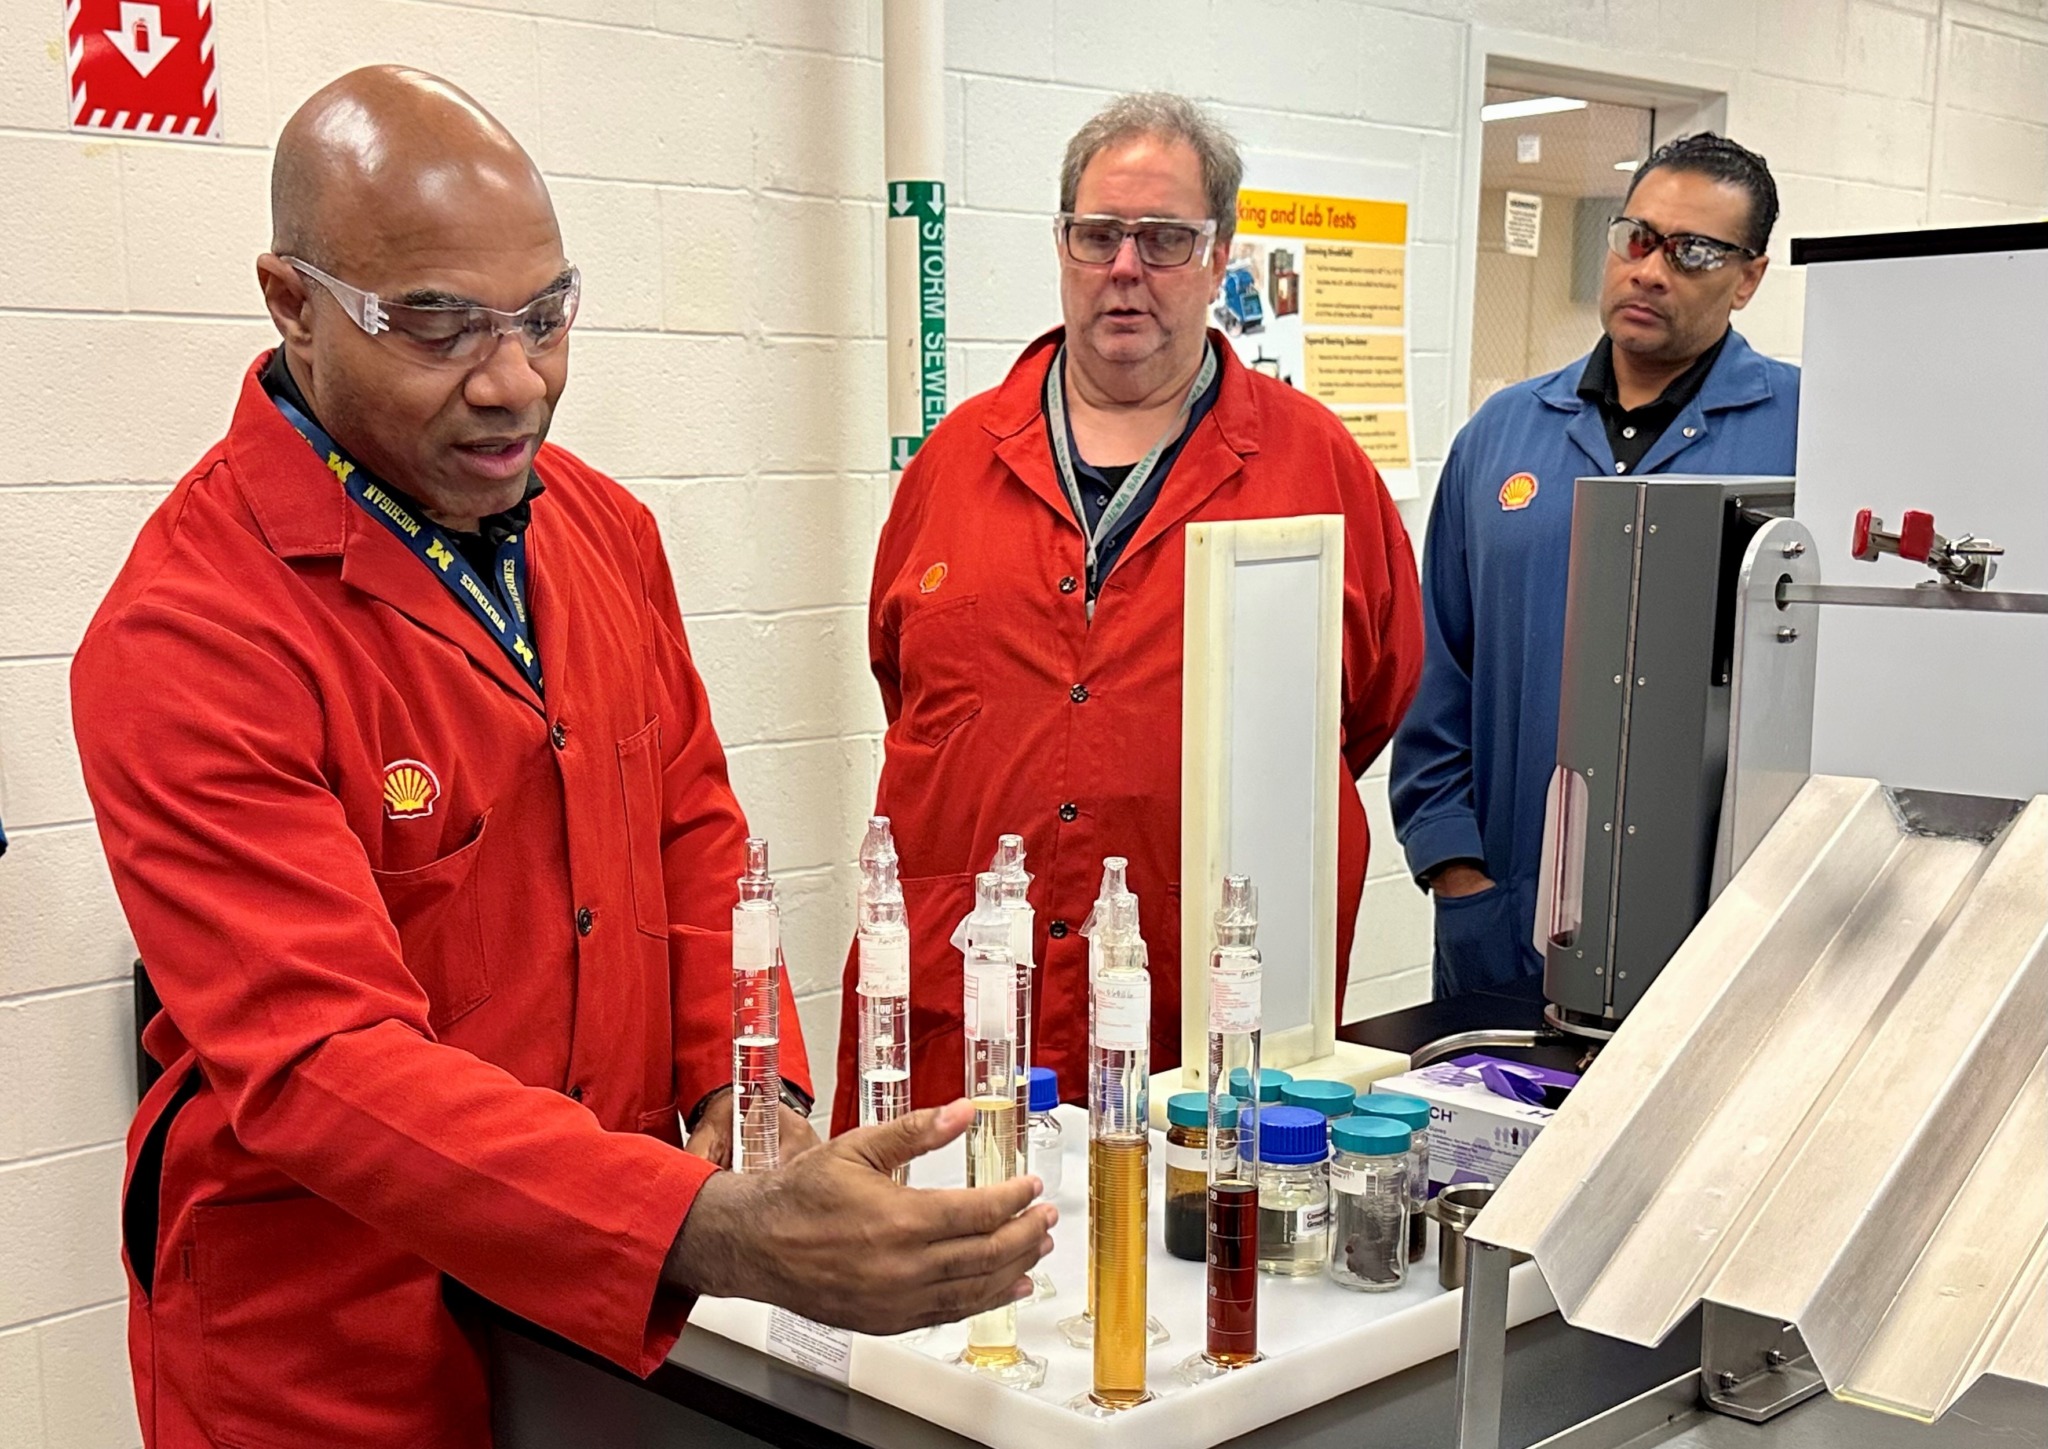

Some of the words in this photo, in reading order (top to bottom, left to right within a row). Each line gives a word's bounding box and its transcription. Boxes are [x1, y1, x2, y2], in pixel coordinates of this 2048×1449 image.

[1270, 202, 1296, 225] and
[1300, 204, 1323, 227] Lab
[1327, 206, 1356, 230] Tests
[922, 220, 945, 319] STORM
[362, 484, 420, 538] MICHIGAN
[460, 573, 506, 633] WOLVERINES
